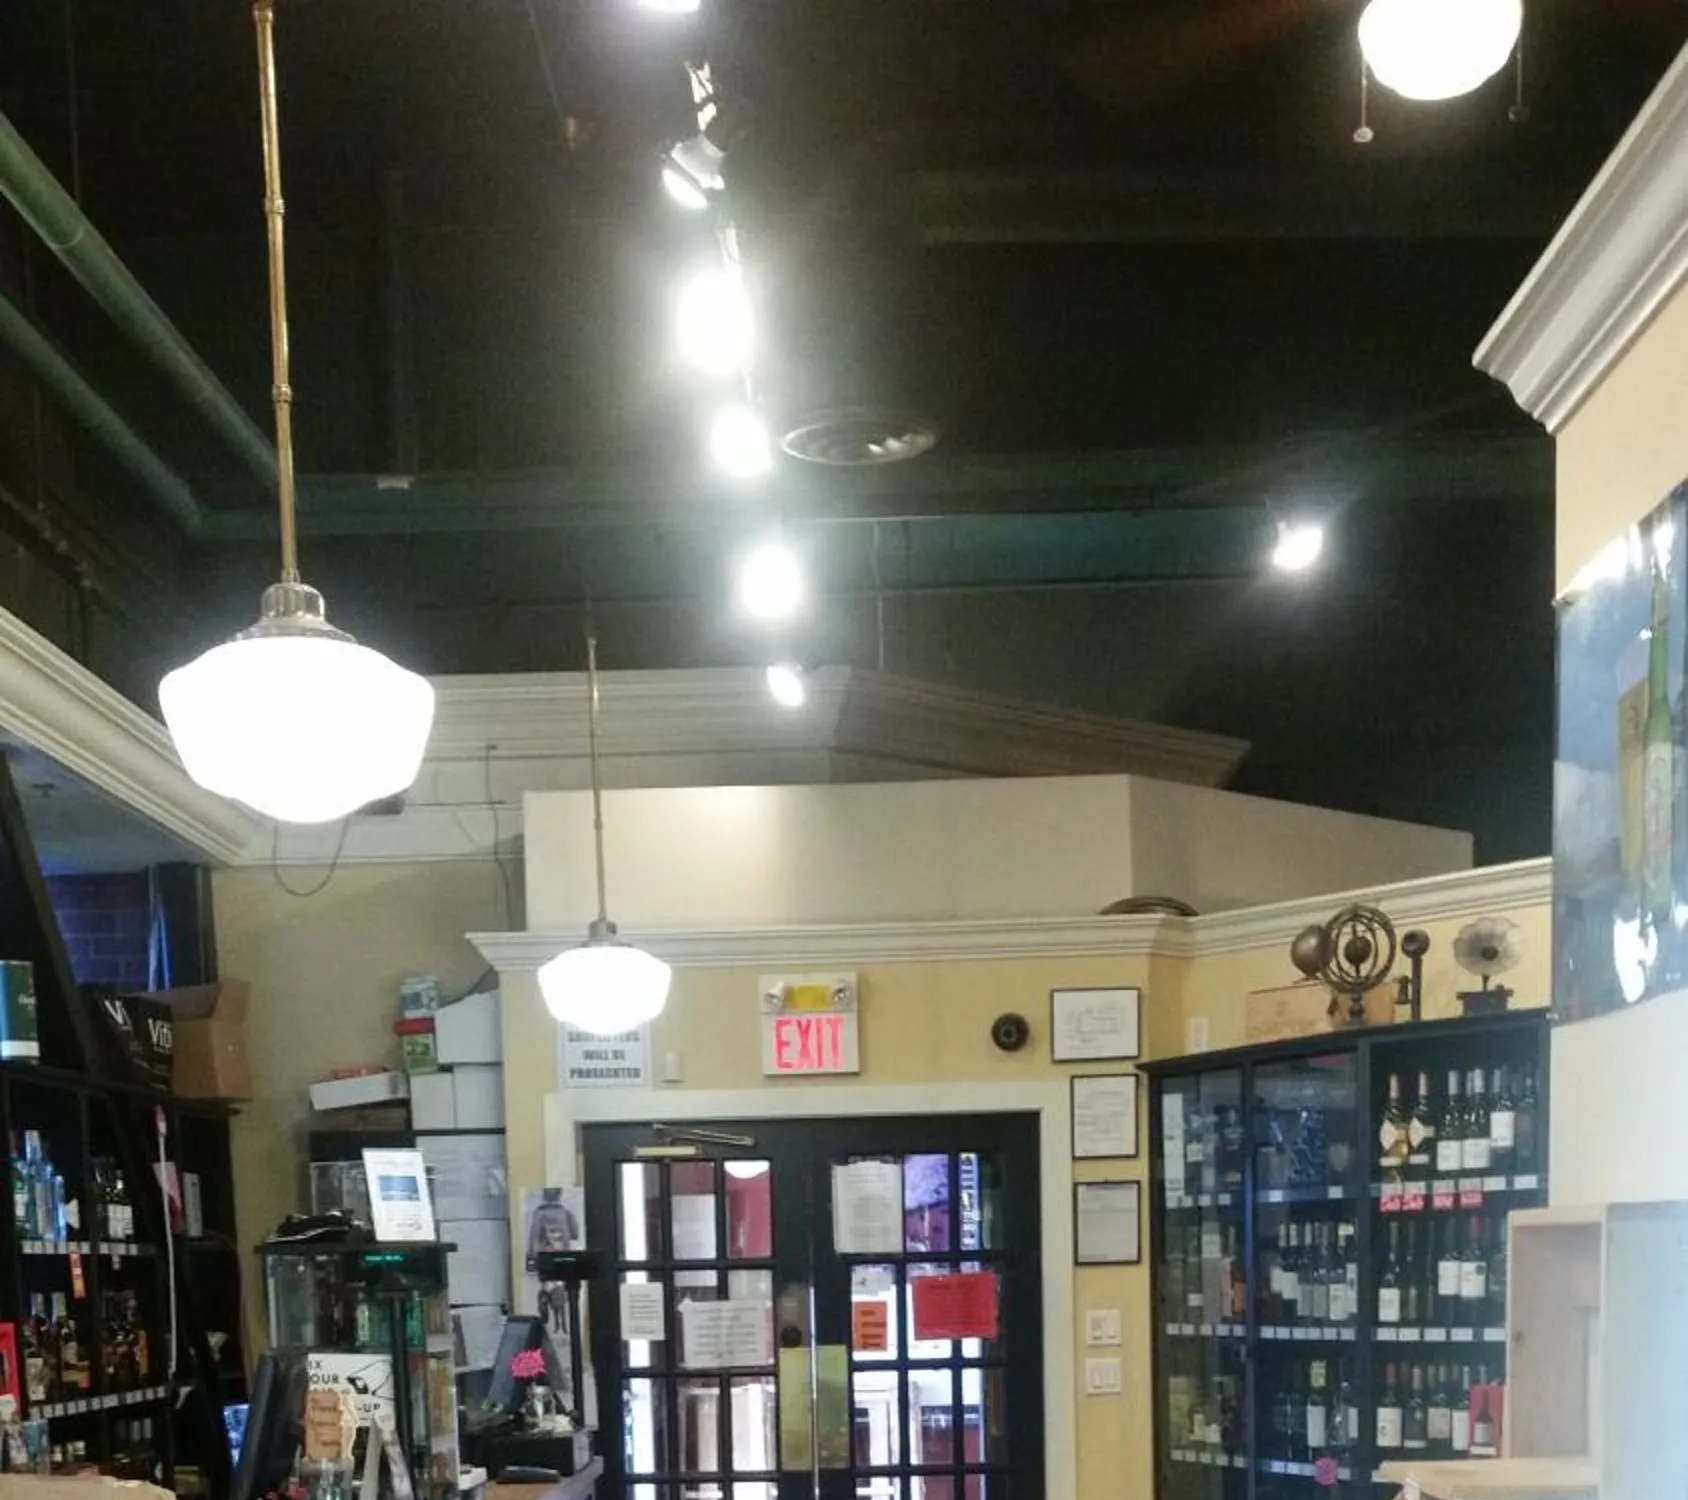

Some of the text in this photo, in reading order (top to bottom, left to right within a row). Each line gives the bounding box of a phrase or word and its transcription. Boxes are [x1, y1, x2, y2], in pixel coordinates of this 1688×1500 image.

[774, 1016, 844, 1069] EXIT
[583, 1049, 609, 1061] WILL
[569, 1066, 641, 1079] PROSECUTED
